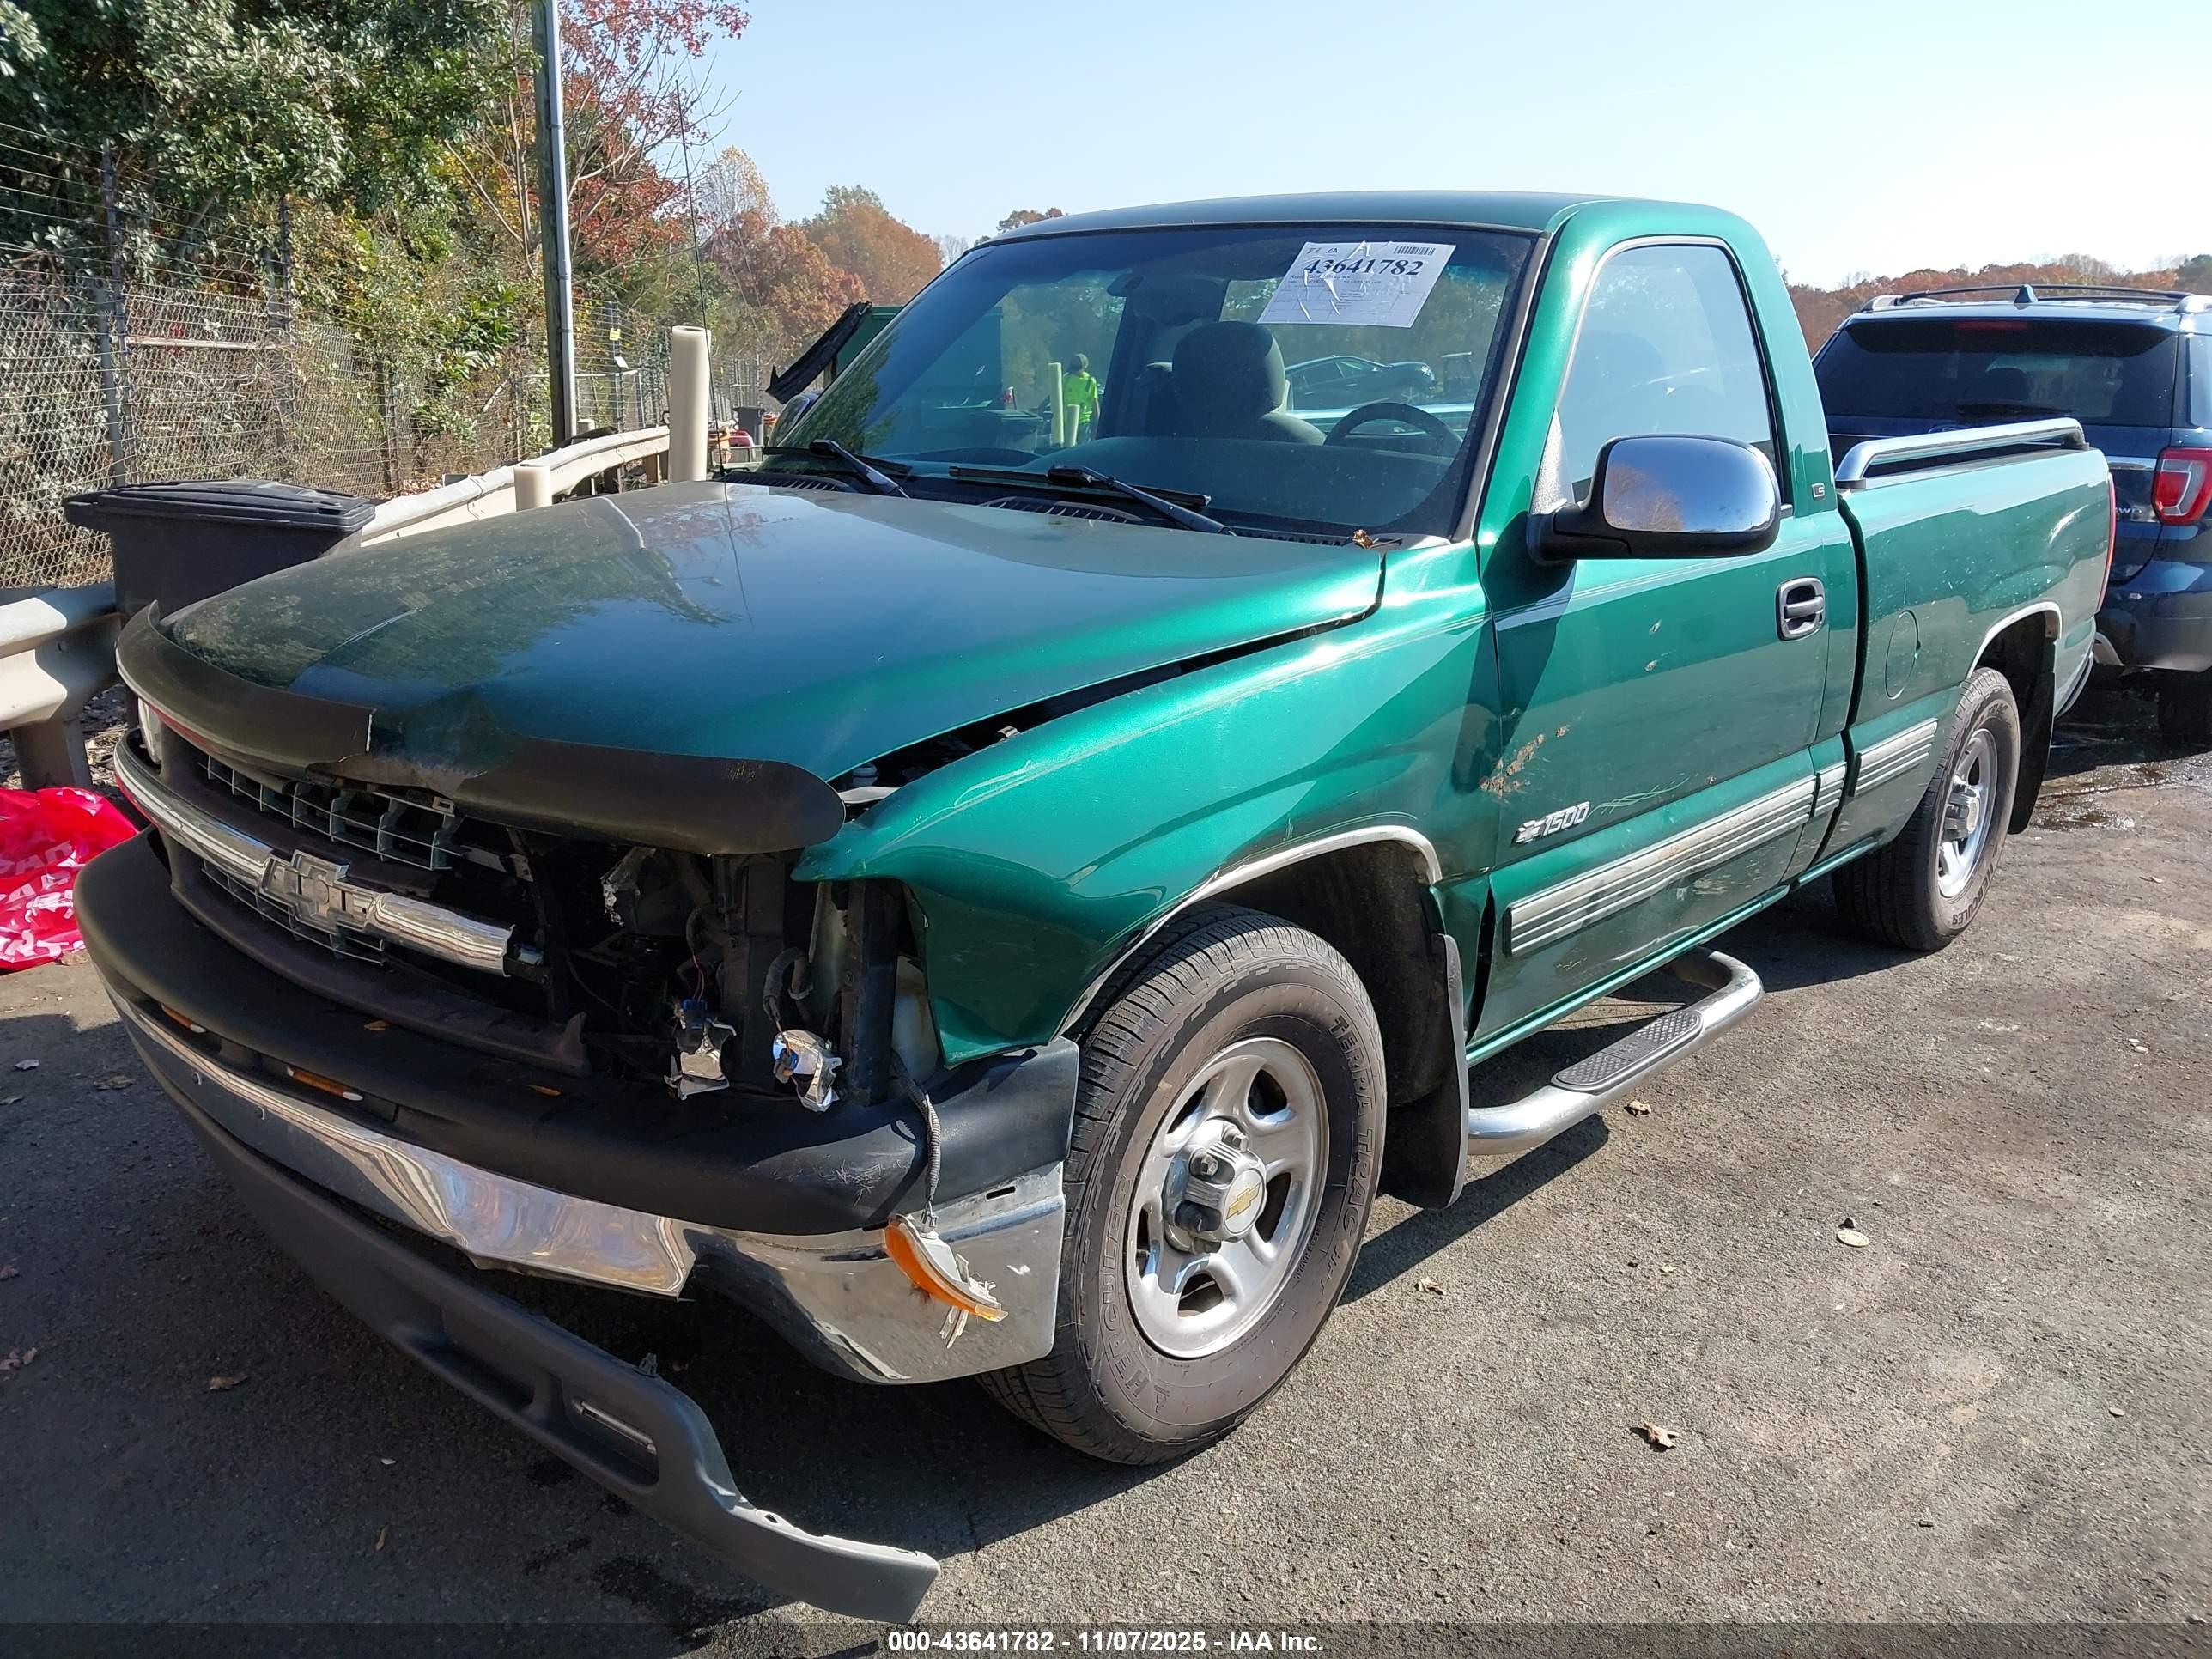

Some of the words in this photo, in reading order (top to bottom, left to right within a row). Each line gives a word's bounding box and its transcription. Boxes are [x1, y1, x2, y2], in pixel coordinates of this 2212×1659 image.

[1304, 258, 1425, 276] 43641782
[1812, 483, 1826, 498] LS
[1543, 801, 1590, 836] 1500
[1952, 864, 1994, 925] HERCULES
[1328, 1015, 1373, 1120] TERRA
[1343, 1128, 1373, 1237] TRAC
[1103, 1178, 1149, 1398] HERCULES
